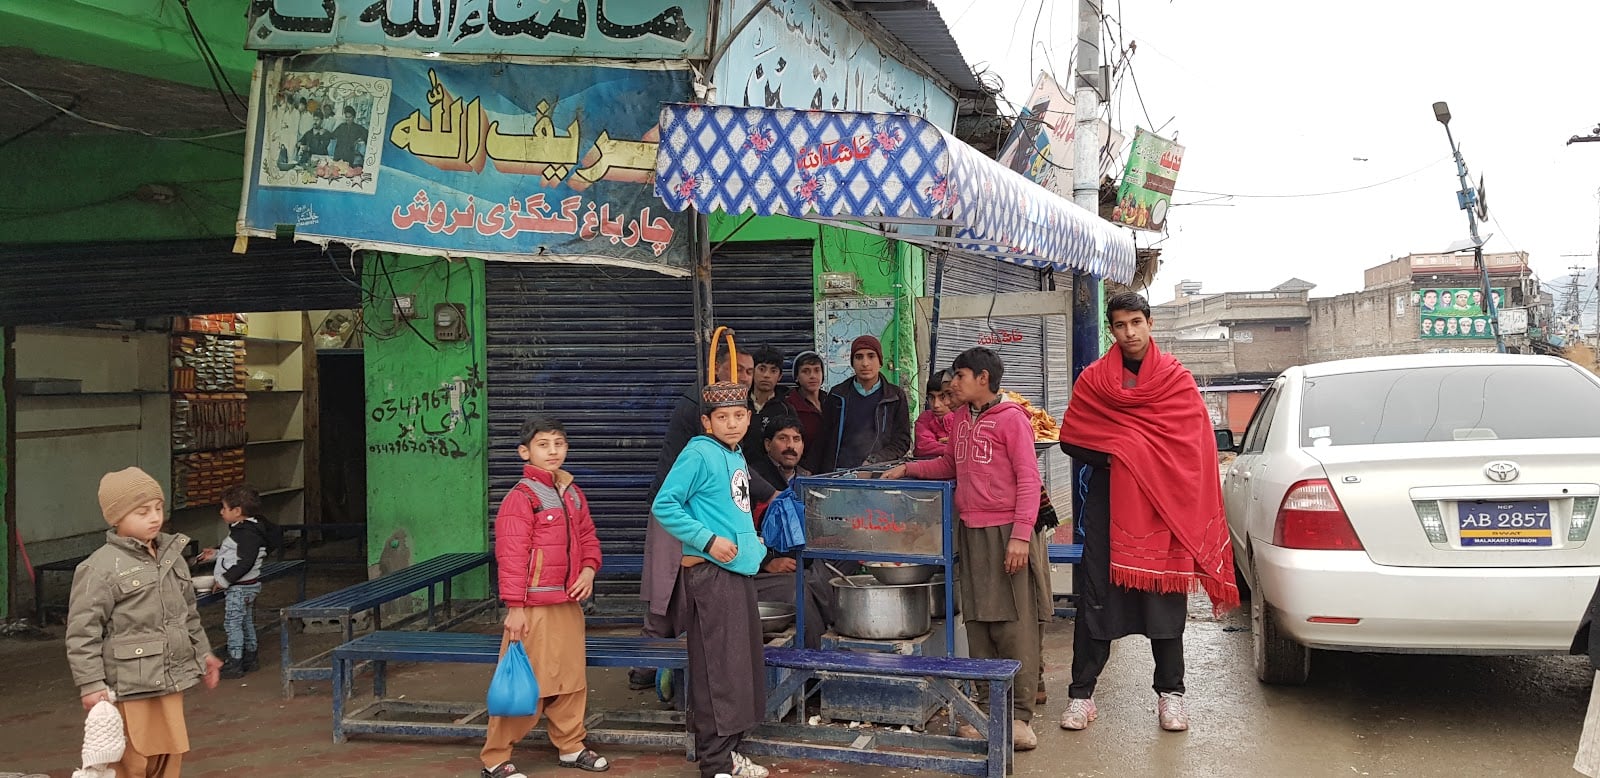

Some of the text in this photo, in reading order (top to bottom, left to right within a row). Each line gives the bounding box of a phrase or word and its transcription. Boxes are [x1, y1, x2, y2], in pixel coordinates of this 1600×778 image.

[486, 99, 659, 182] ریف
[391, 189, 476, 235] فروش
[476, 194, 582, 239] گنگڑی
[954, 419, 997, 464] 85
[1461, 513, 1548, 527] AB 2857
